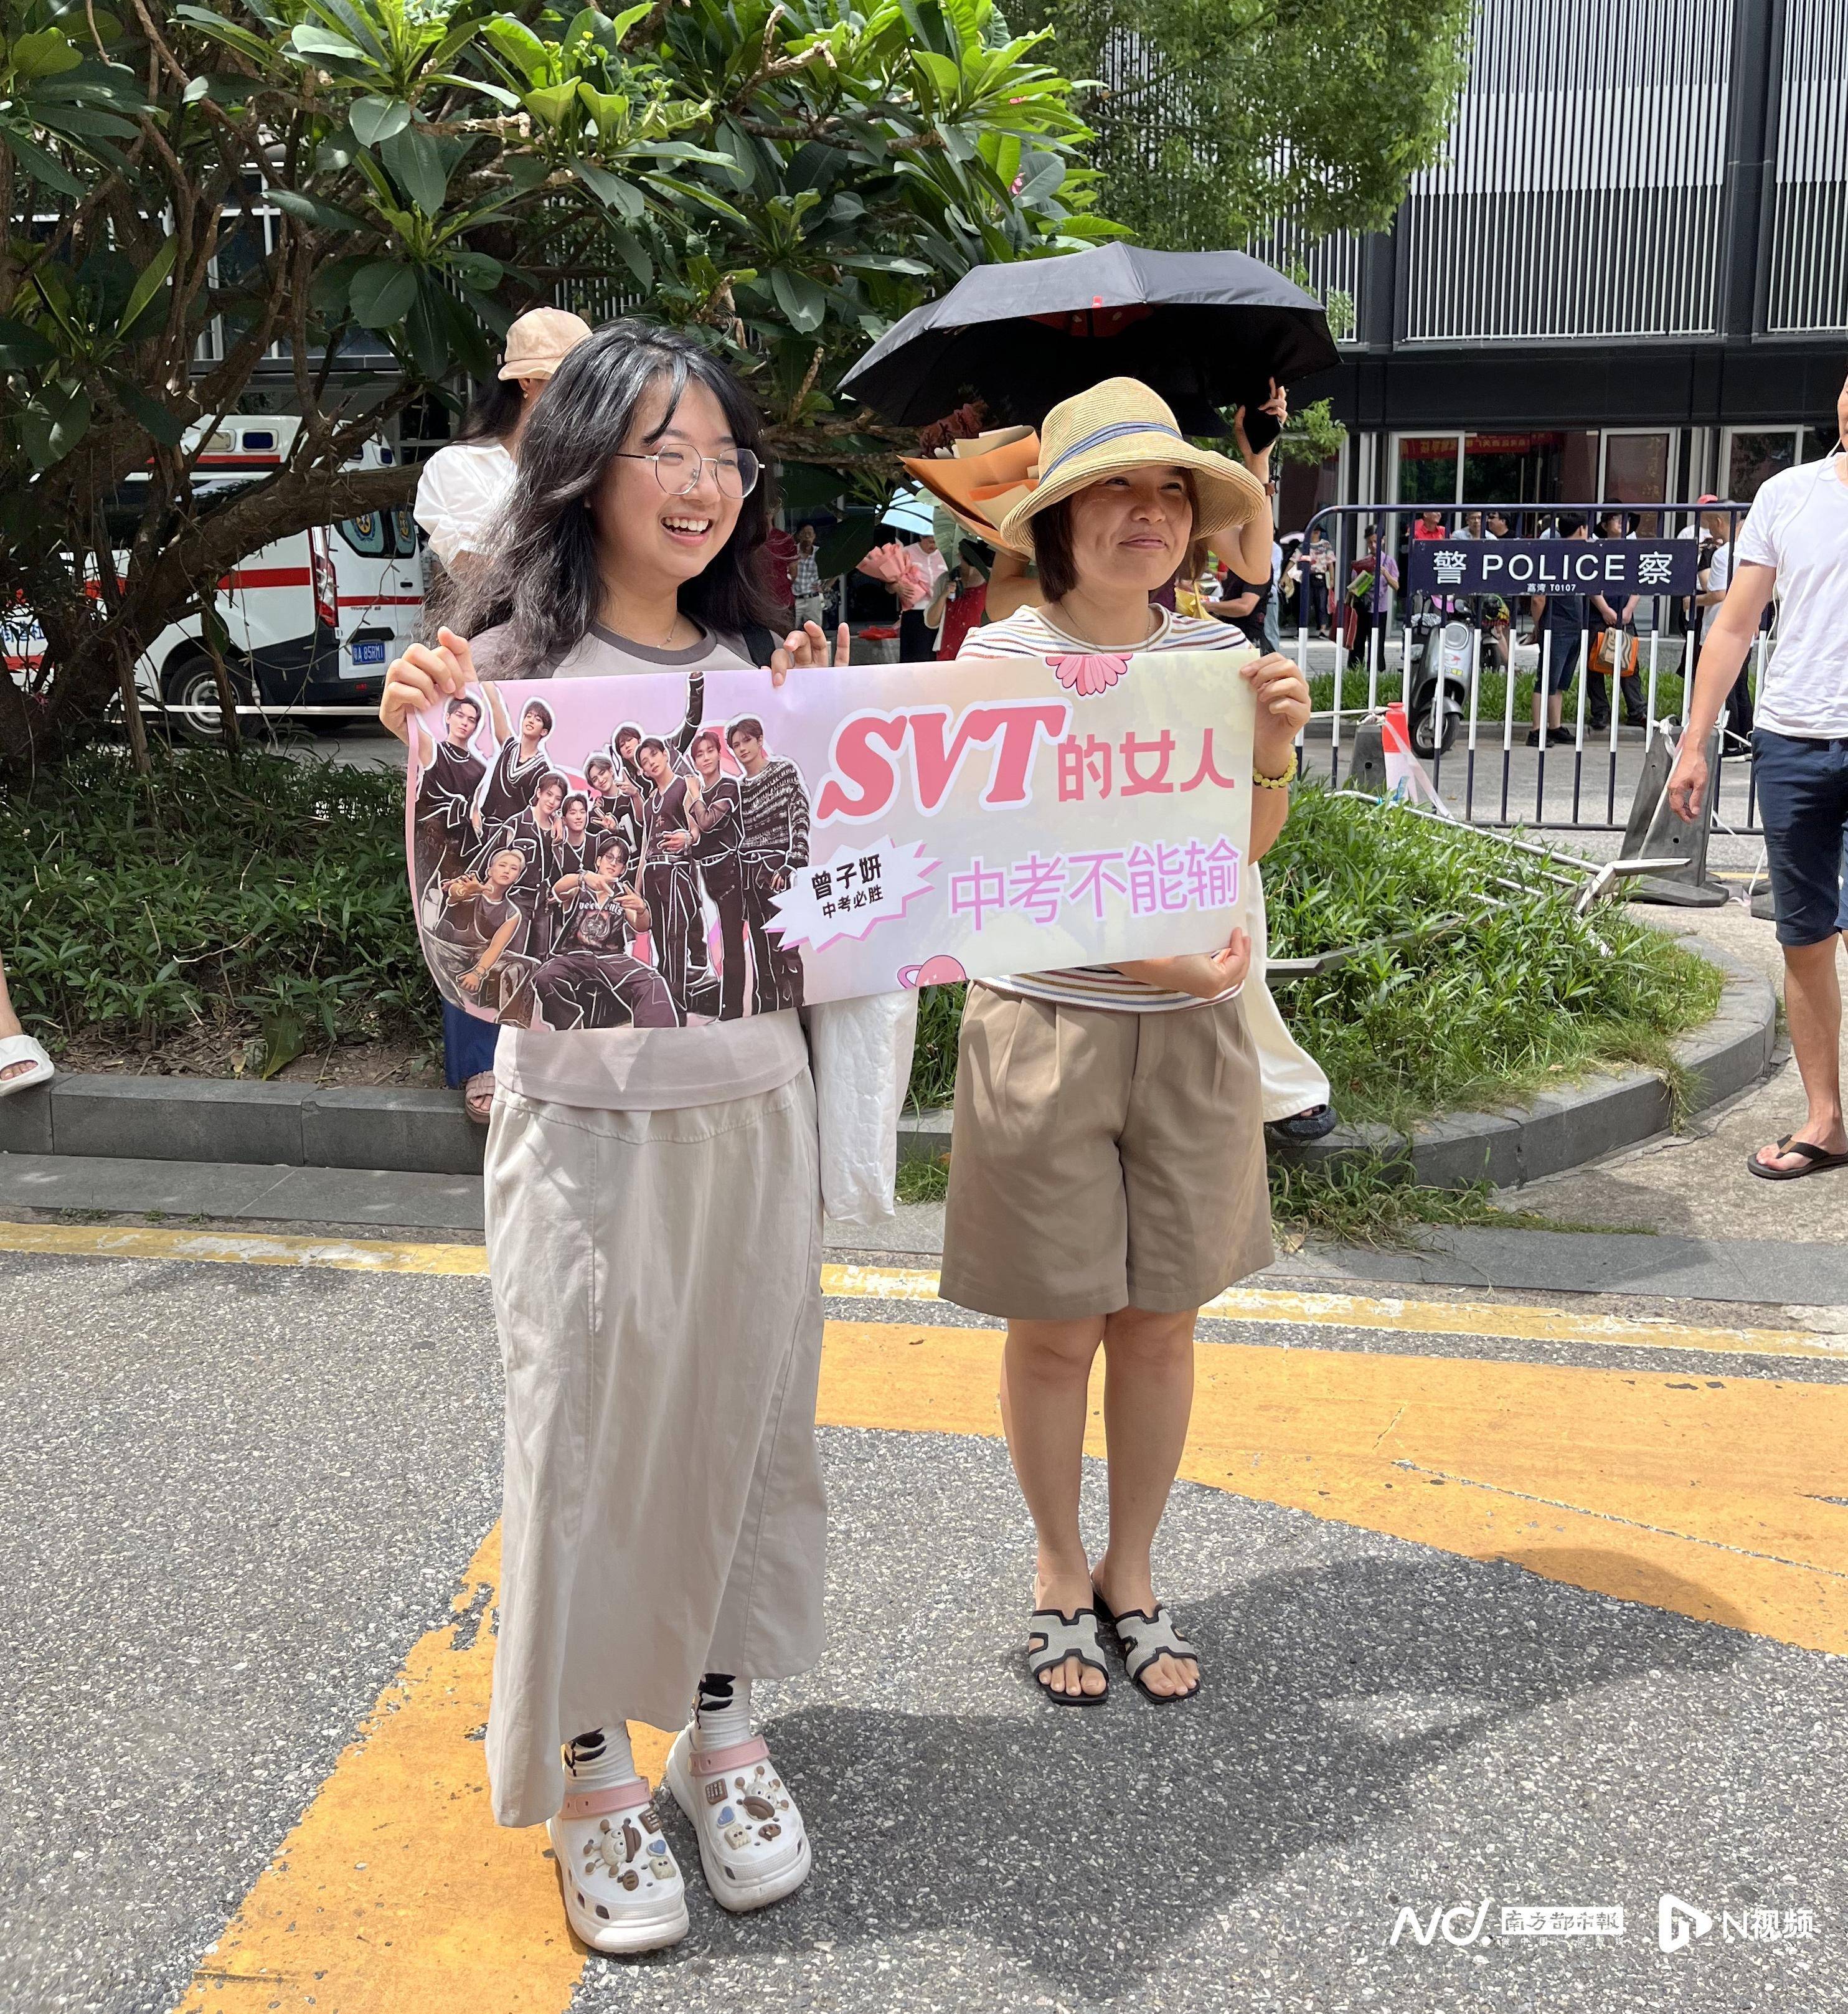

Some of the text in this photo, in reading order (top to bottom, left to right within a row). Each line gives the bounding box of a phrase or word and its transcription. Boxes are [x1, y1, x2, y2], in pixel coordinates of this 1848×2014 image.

[1433, 550, 1673, 585] 警 POLICE 察
[1550, 584, 1576, 592] T0107
[811, 854, 882, 901] 曾子妍
[950, 838, 1240, 931] 中考不能输
[822, 884, 884, 919] 中考必胜
